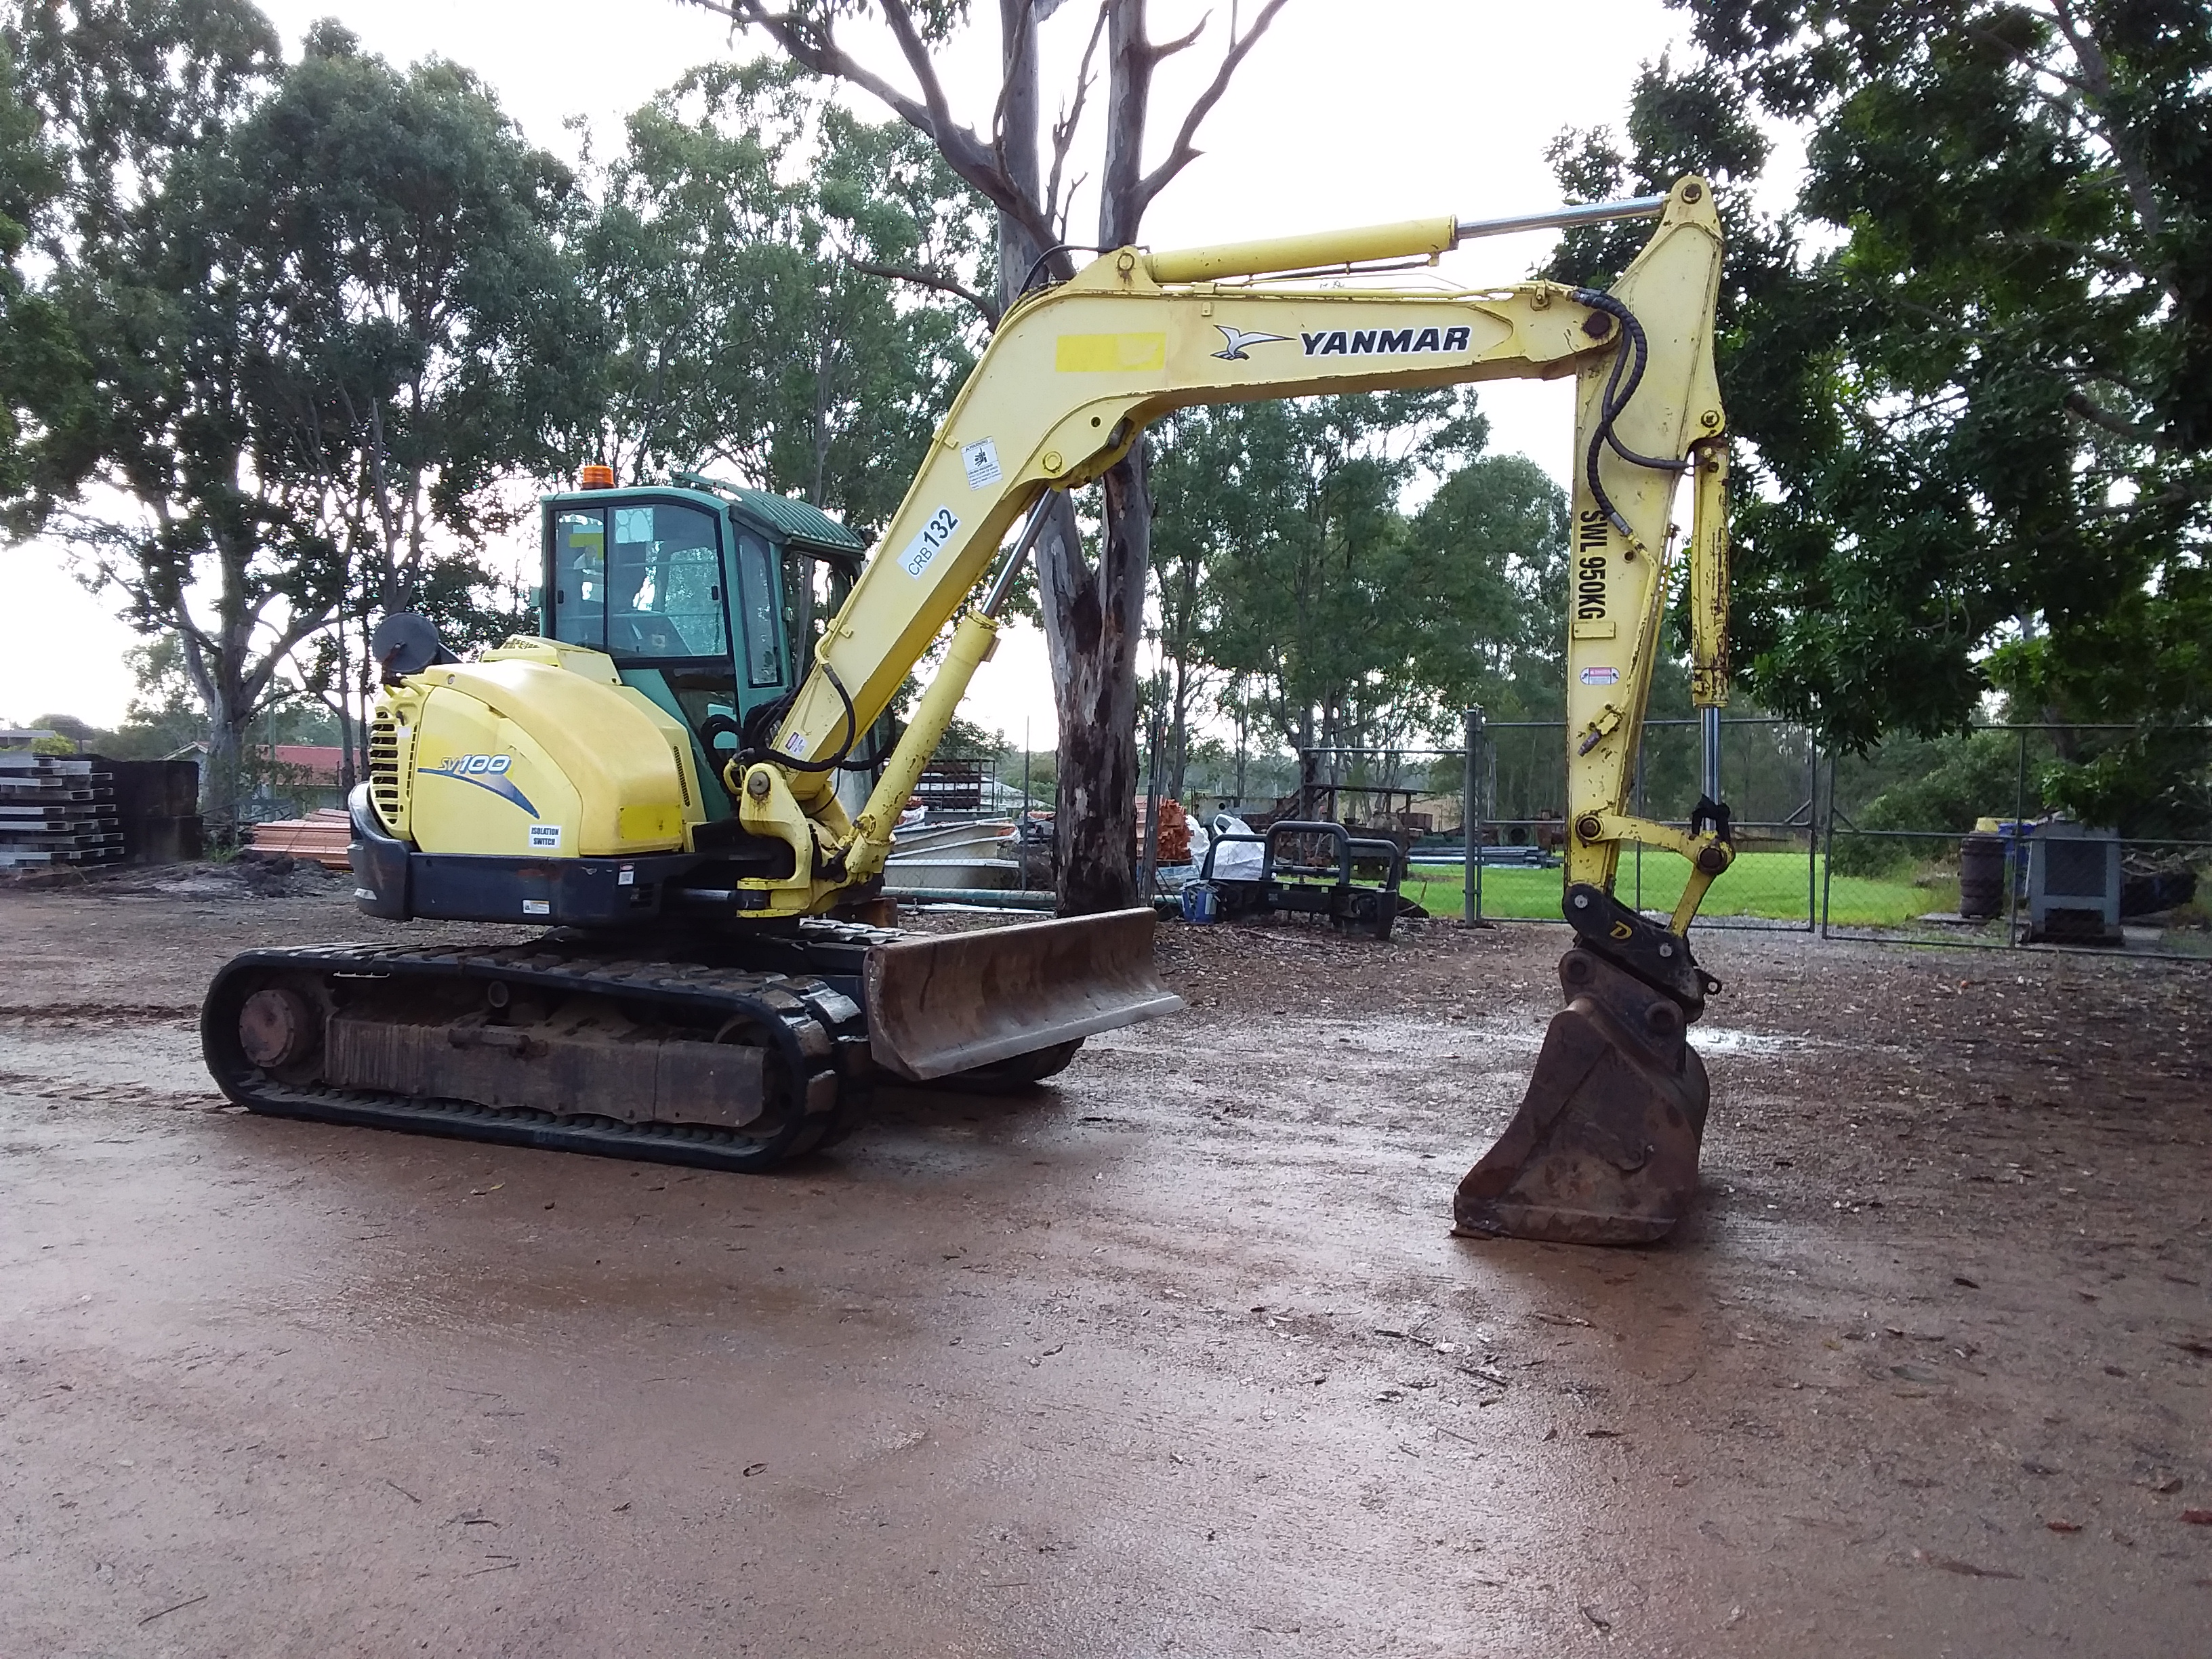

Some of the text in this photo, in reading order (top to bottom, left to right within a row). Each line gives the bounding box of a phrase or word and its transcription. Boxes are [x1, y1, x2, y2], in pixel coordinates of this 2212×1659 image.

[1300, 327, 1471, 355] YANMAR
[908, 509, 958, 575] CRB 132
[1578, 510, 1608, 620] SWL 950KG
[531, 827, 559, 836] ISOLATION
[533, 837, 556, 846] SWITCH
